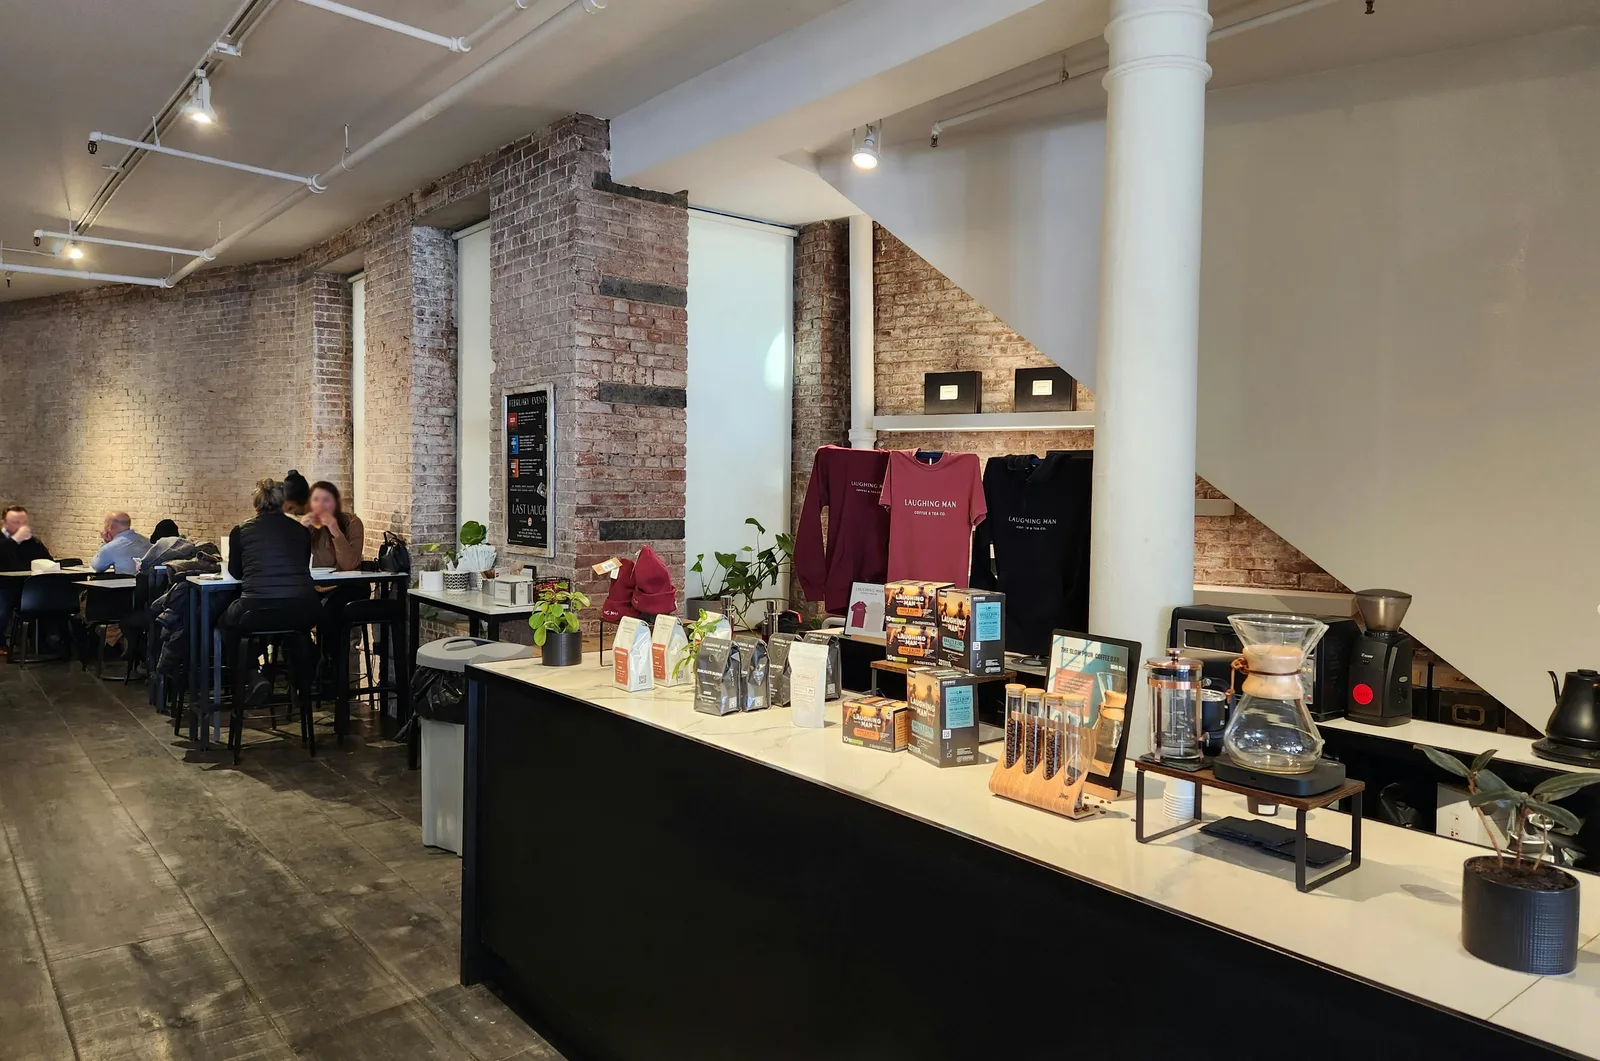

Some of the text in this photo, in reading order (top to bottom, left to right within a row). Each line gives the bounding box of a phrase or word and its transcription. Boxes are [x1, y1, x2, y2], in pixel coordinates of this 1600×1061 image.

[509, 396, 547, 408] FEBRUARY EVENTS
[904, 499, 940, 507] LAUGHING
[512, 504, 547, 516] LAST LAUGH
[1008, 516, 1041, 524] LAUGHING
[941, 615, 966, 626] LAUGHING
[947, 624, 958, 632] MAN
[1095, 653, 1110, 661] COFFEE
[910, 697, 936, 712] LAUGHING
[917, 708, 927, 717] MAN
[853, 714, 881, 724] LAUGHING
